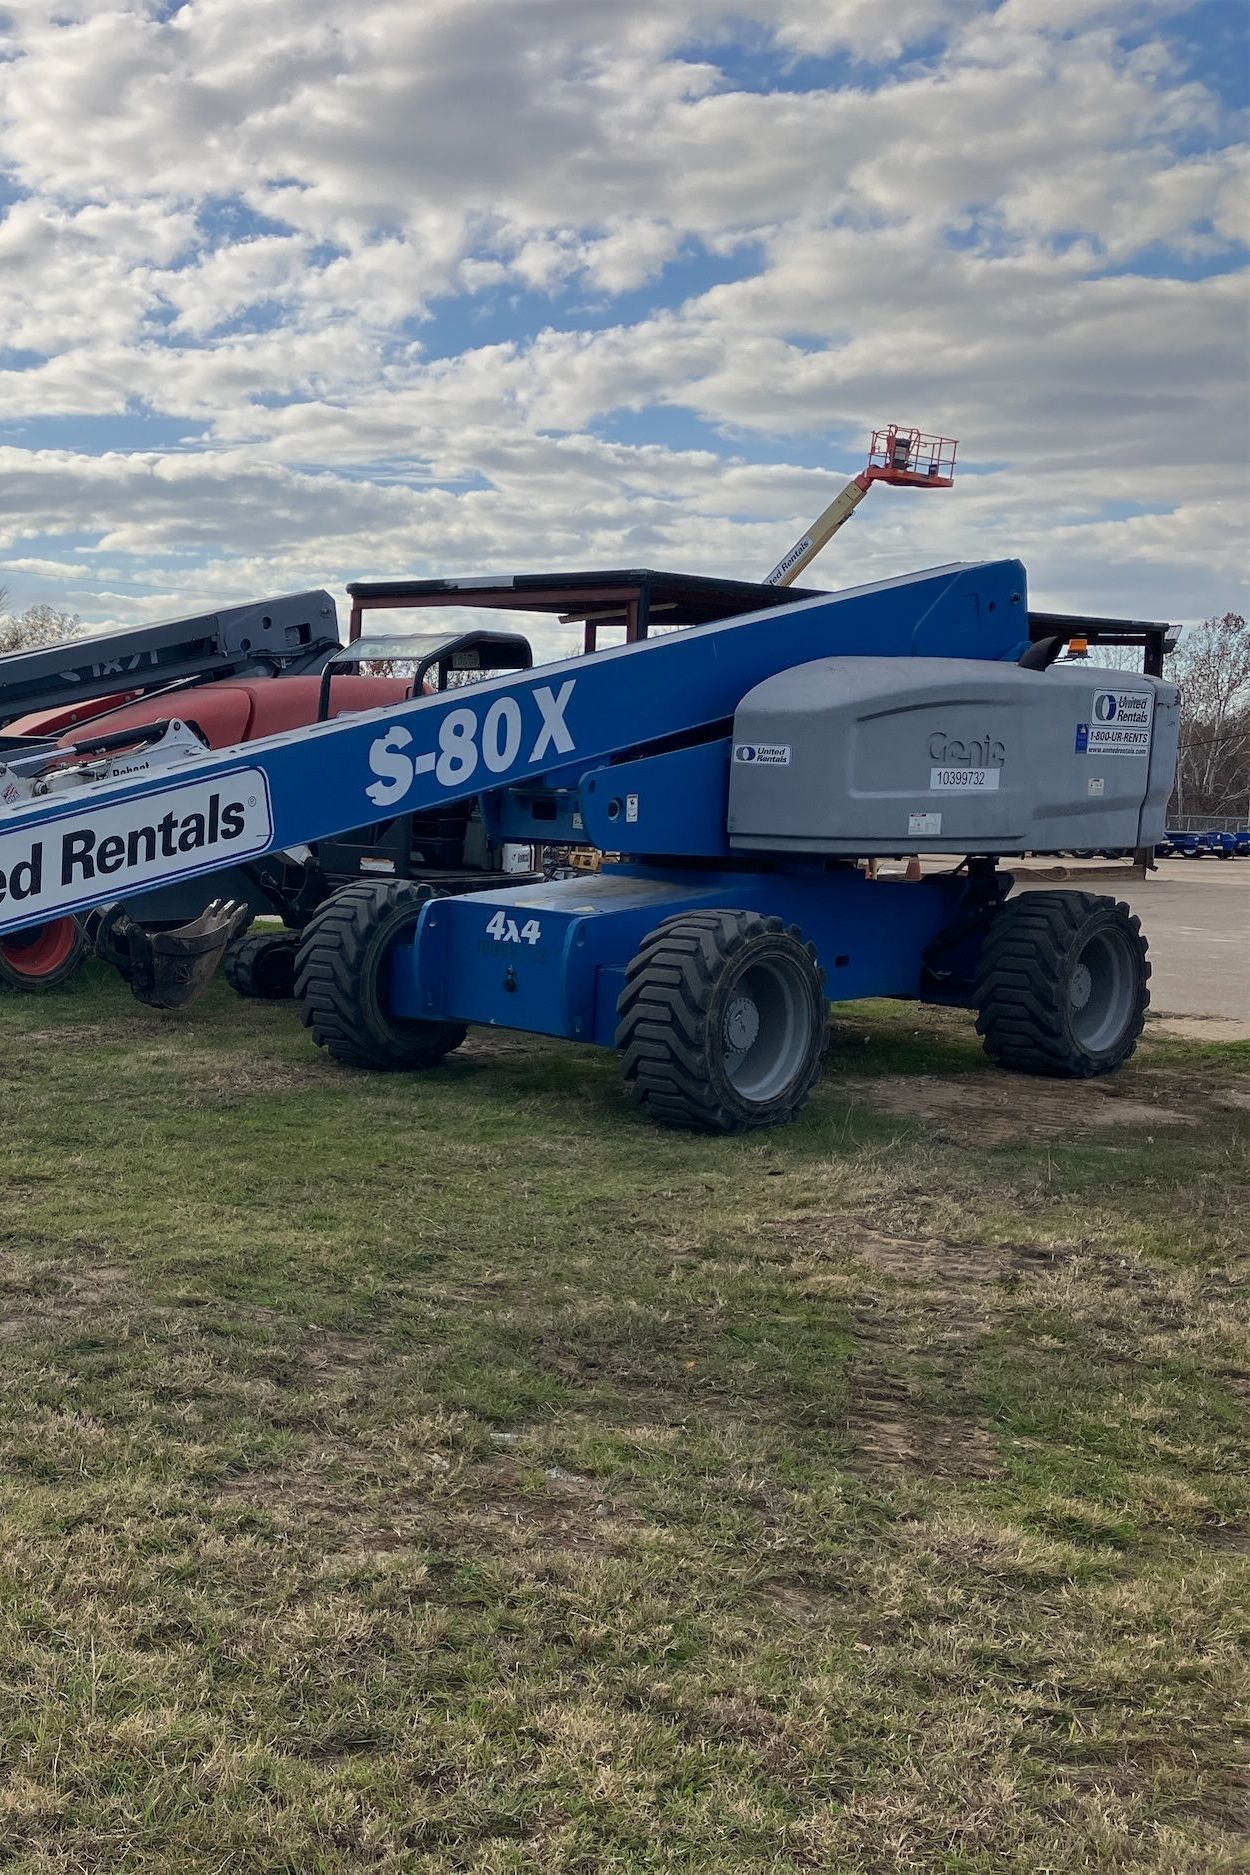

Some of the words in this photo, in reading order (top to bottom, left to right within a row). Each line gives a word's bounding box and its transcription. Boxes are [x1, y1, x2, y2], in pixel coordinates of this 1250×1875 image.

[781, 541, 809, 572] Rentals
[1119, 696, 1148, 709] United
[1117, 710, 1148, 723] Rentals
[1090, 731, 1148, 743] 1-800-UR-RENTS
[757, 747, 786, 755] United
[928, 731, 1005, 767] Genie
[756, 755, 787, 763] Rentals
[937, 771, 985, 785] 10399732
[61, 793, 245, 886] Rentals
